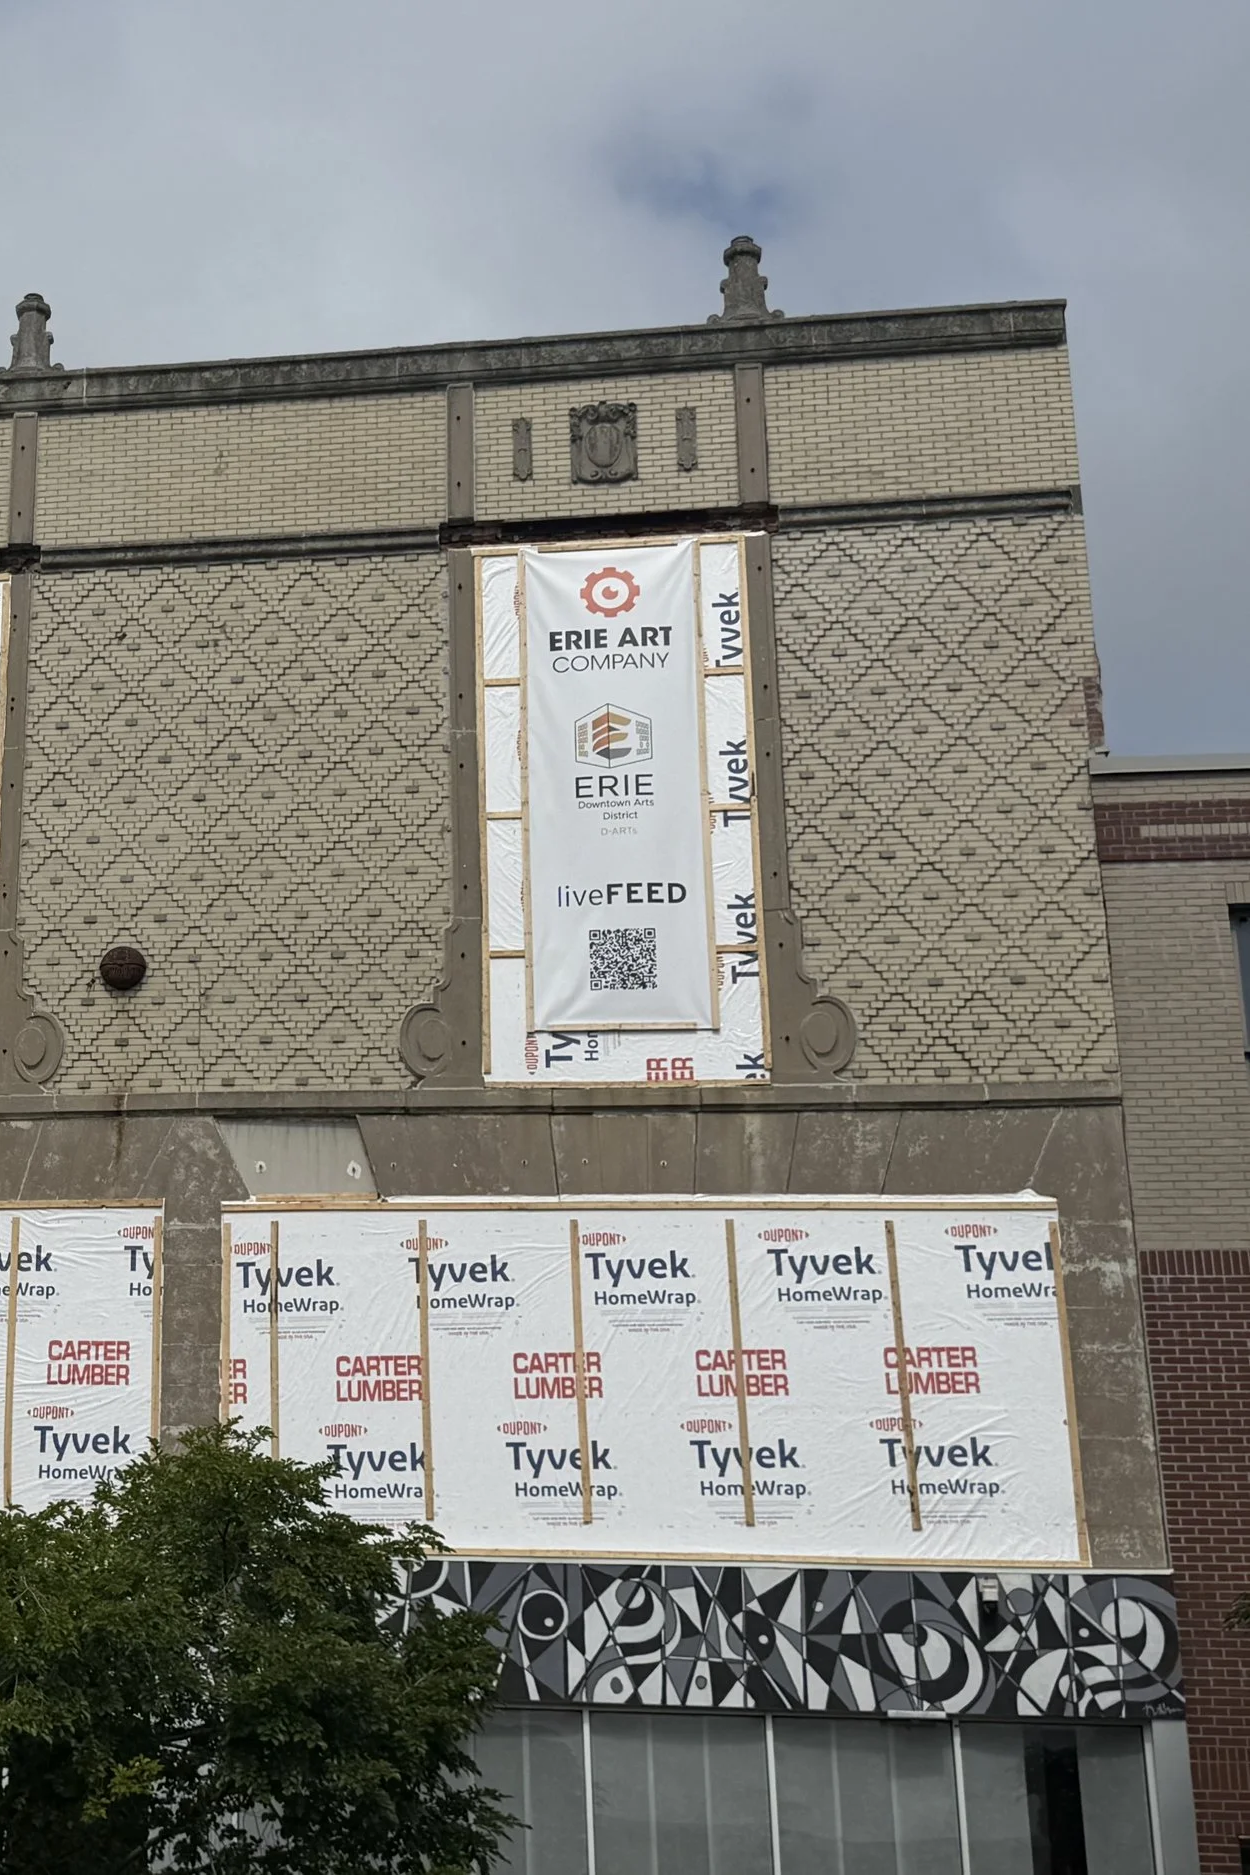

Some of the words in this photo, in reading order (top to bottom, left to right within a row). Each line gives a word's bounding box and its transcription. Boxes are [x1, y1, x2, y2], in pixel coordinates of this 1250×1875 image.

[550, 628, 608, 652] ERIE
[617, 626, 672, 647] ART
[552, 651, 669, 673] COMPANY
[575, 774, 654, 798] ERIE
[578, 800, 630, 809] Downtown
[634, 798, 654, 807] Arts
[603, 811, 638, 820] District
[557, 882, 687, 908] liveFEED
[123, 1226, 154, 1239] DUPON
[582, 1232, 622, 1246] DUPONT
[763, 1228, 805, 1242] DUPONT
[950, 1224, 992, 1238] DUPONT
[233, 1242, 271, 1256] DUPONT
[405, 1237, 444, 1250] DUONT
[408, 1254, 510, 1291] Tyvek
[585, 1250, 690, 1287] Tyvek
[767, 1246, 877, 1284] Tyvek
[236, 1258, 335, 1296] Tyvek
[594, 1290, 697, 1307] HomeWrap
[778, 1286, 883, 1304] HomeWrap
[48, 1340, 130, 1361] CARTER
[883, 1346, 978, 1369] CARTER
[335, 1355, 424, 1376] CARTER
[513, 1352, 601, 1374] CARTER
[46, 1363, 130, 1386] LUMBER
[335, 1379, 423, 1402] LUMBER
[32, 1406, 70, 1420] DUPONT
[324, 1423, 362, 1438] DUPONT
[502, 1421, 542, 1435] DUPONT
[686, 1418, 727, 1433] DUPONT
[34, 1425, 132, 1461] Tyvek
[327, 1442, 425, 1480] Tyvek
[506, 1440, 611, 1478] Tyvek
[689, 1438, 800, 1477] Tyvek
[335, 1483, 423, 1498] HomeWra
